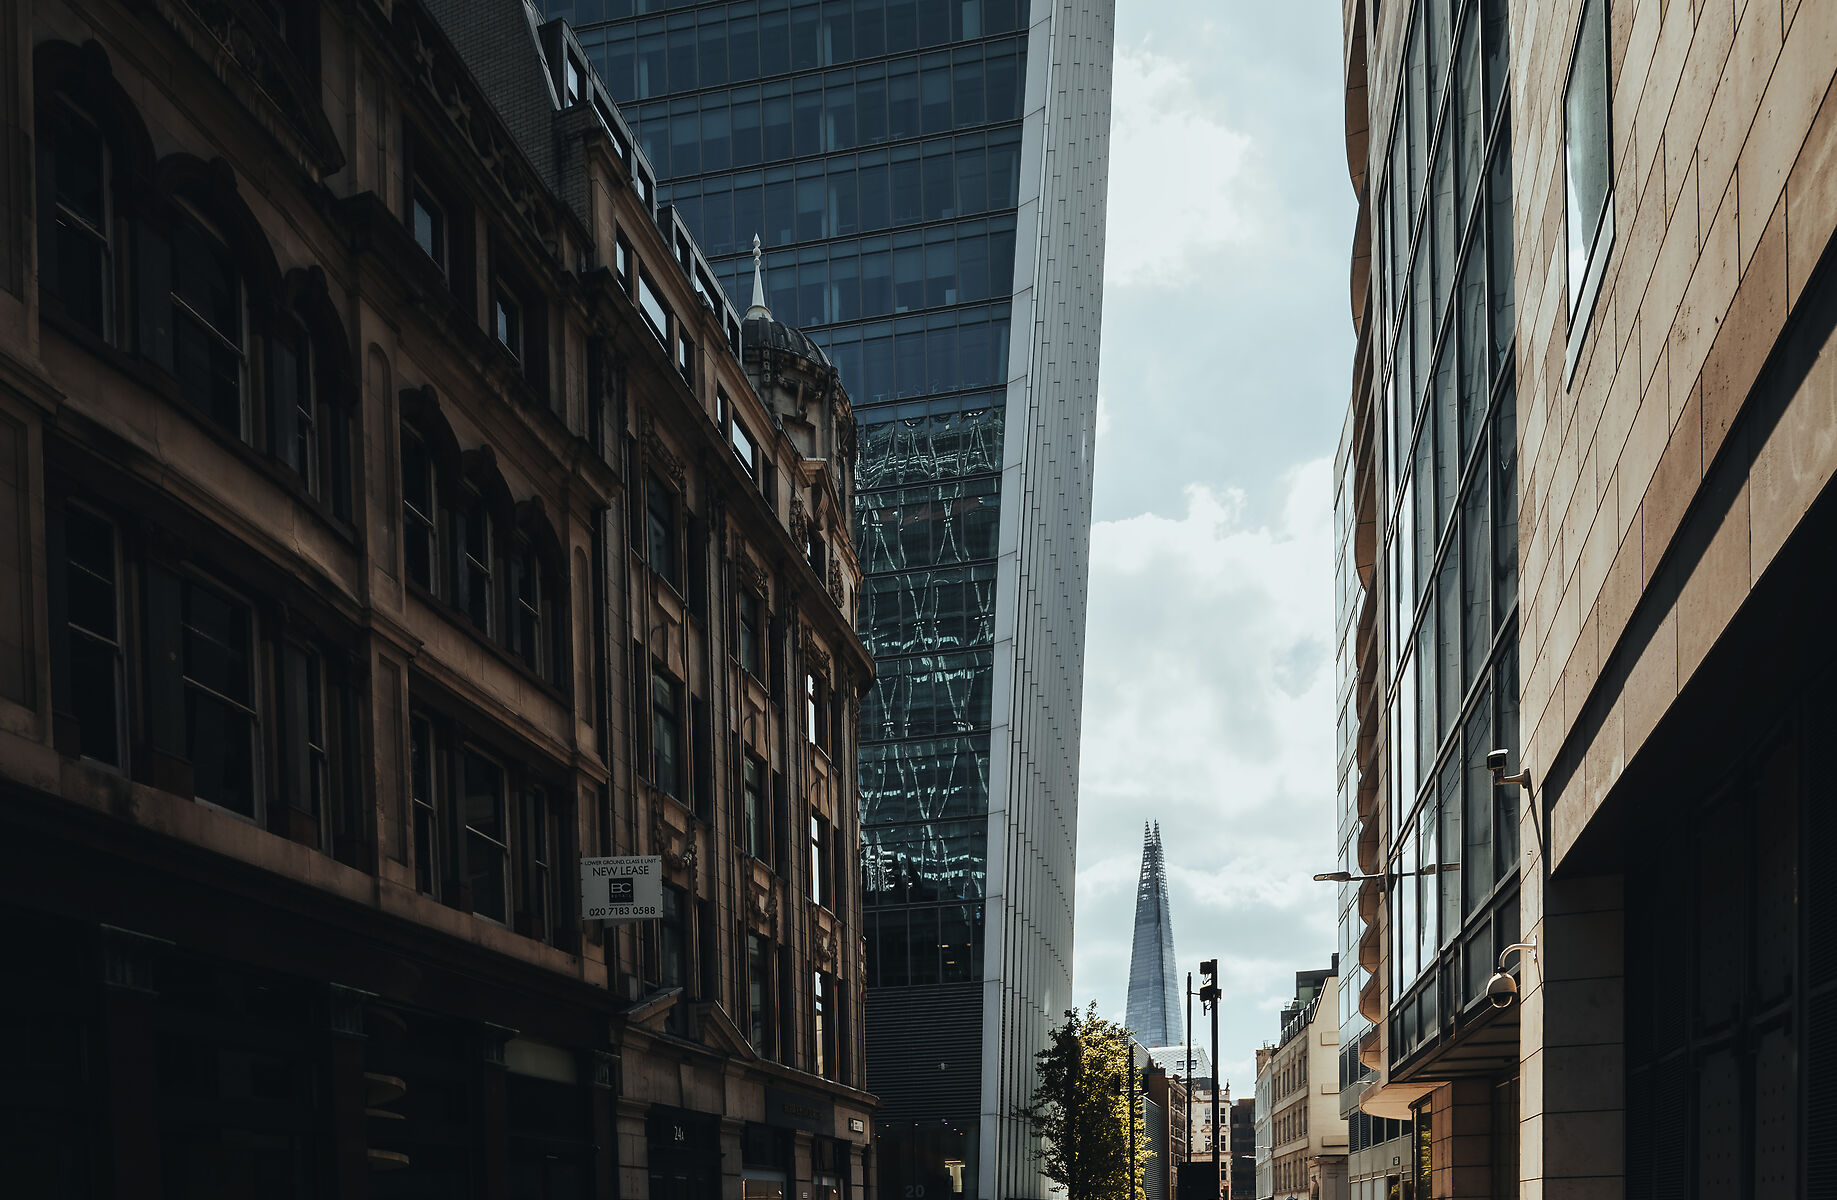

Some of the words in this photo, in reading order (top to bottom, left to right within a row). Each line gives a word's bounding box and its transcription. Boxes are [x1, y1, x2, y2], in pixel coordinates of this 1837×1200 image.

[592, 867, 617, 876] NEW
[620, 866, 649, 875] LEASE
[589, 908, 605, 916] 020
[608, 907, 630, 915] 7183
[633, 907, 656, 915] 0588
[905, 1184, 924, 1198] 20
